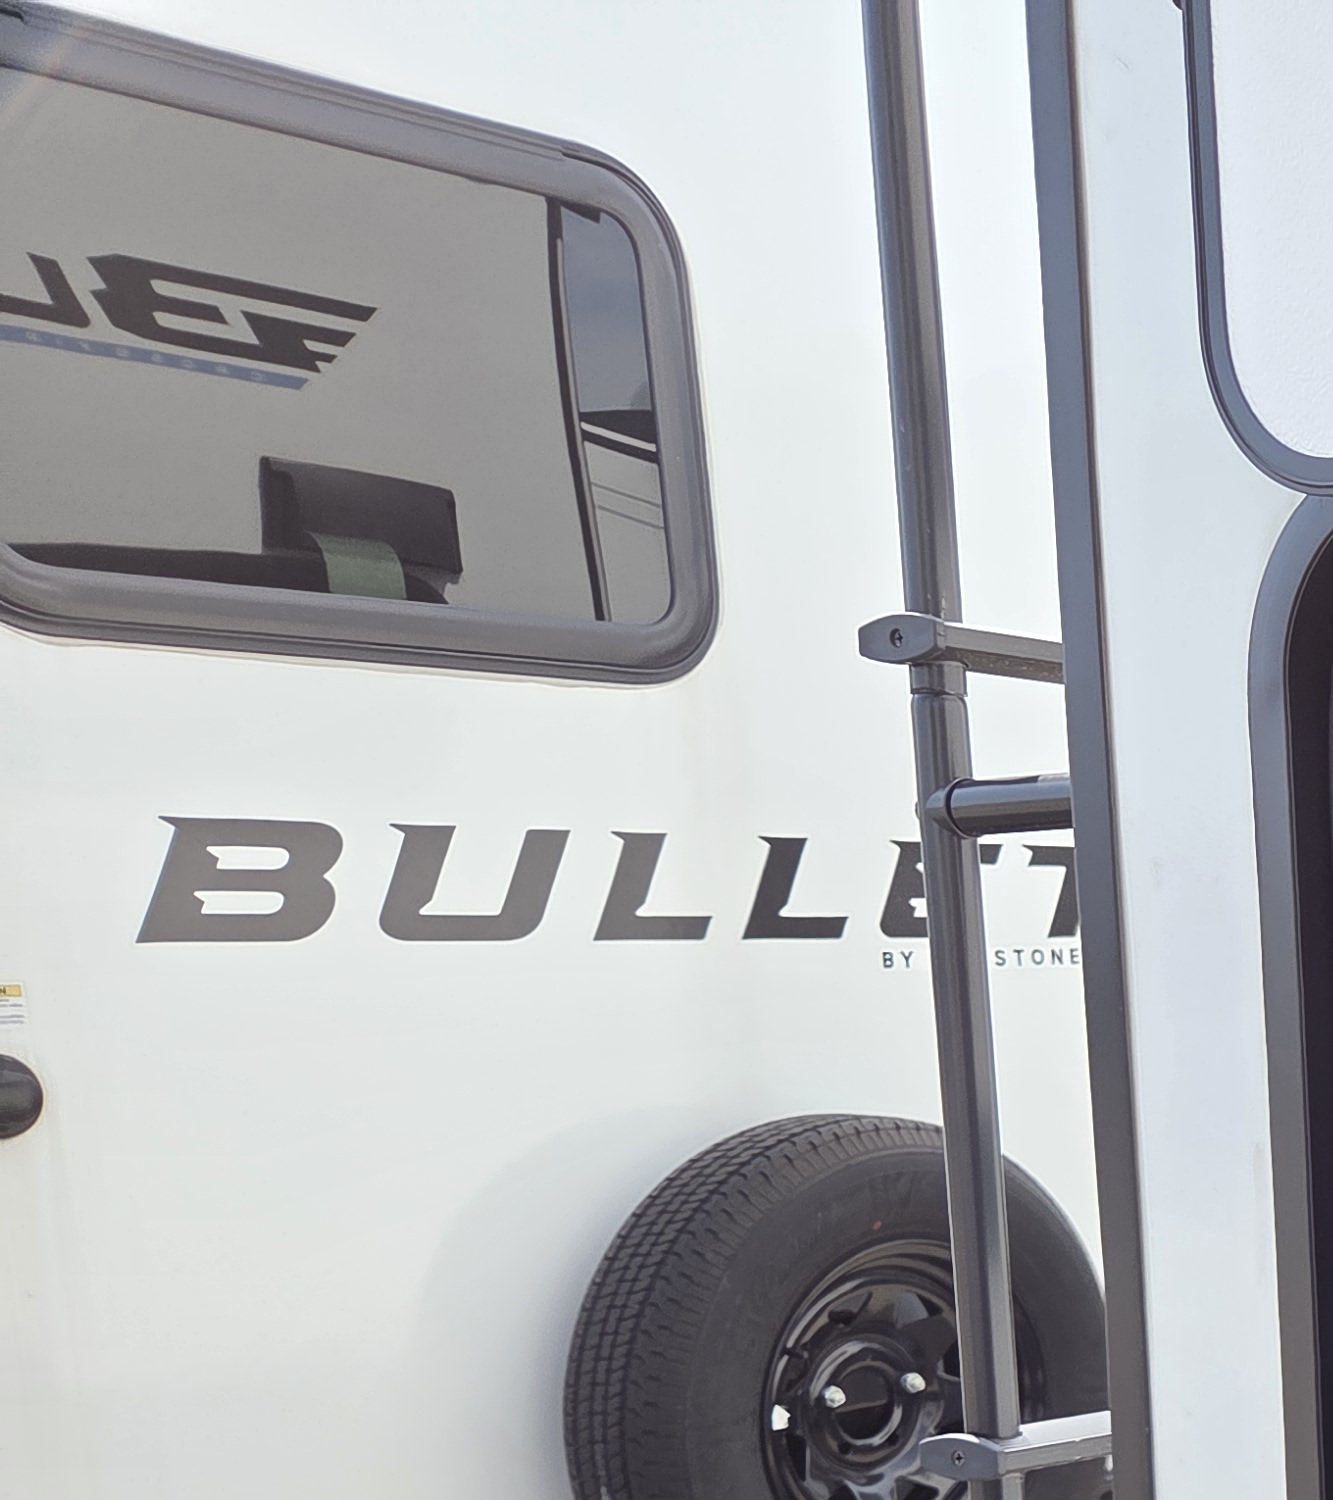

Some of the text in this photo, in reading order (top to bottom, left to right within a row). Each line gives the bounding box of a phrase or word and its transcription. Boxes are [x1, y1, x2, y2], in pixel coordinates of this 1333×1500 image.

[136, 815, 1080, 943] BULLET
[882, 948, 1080, 968] BY STONE
